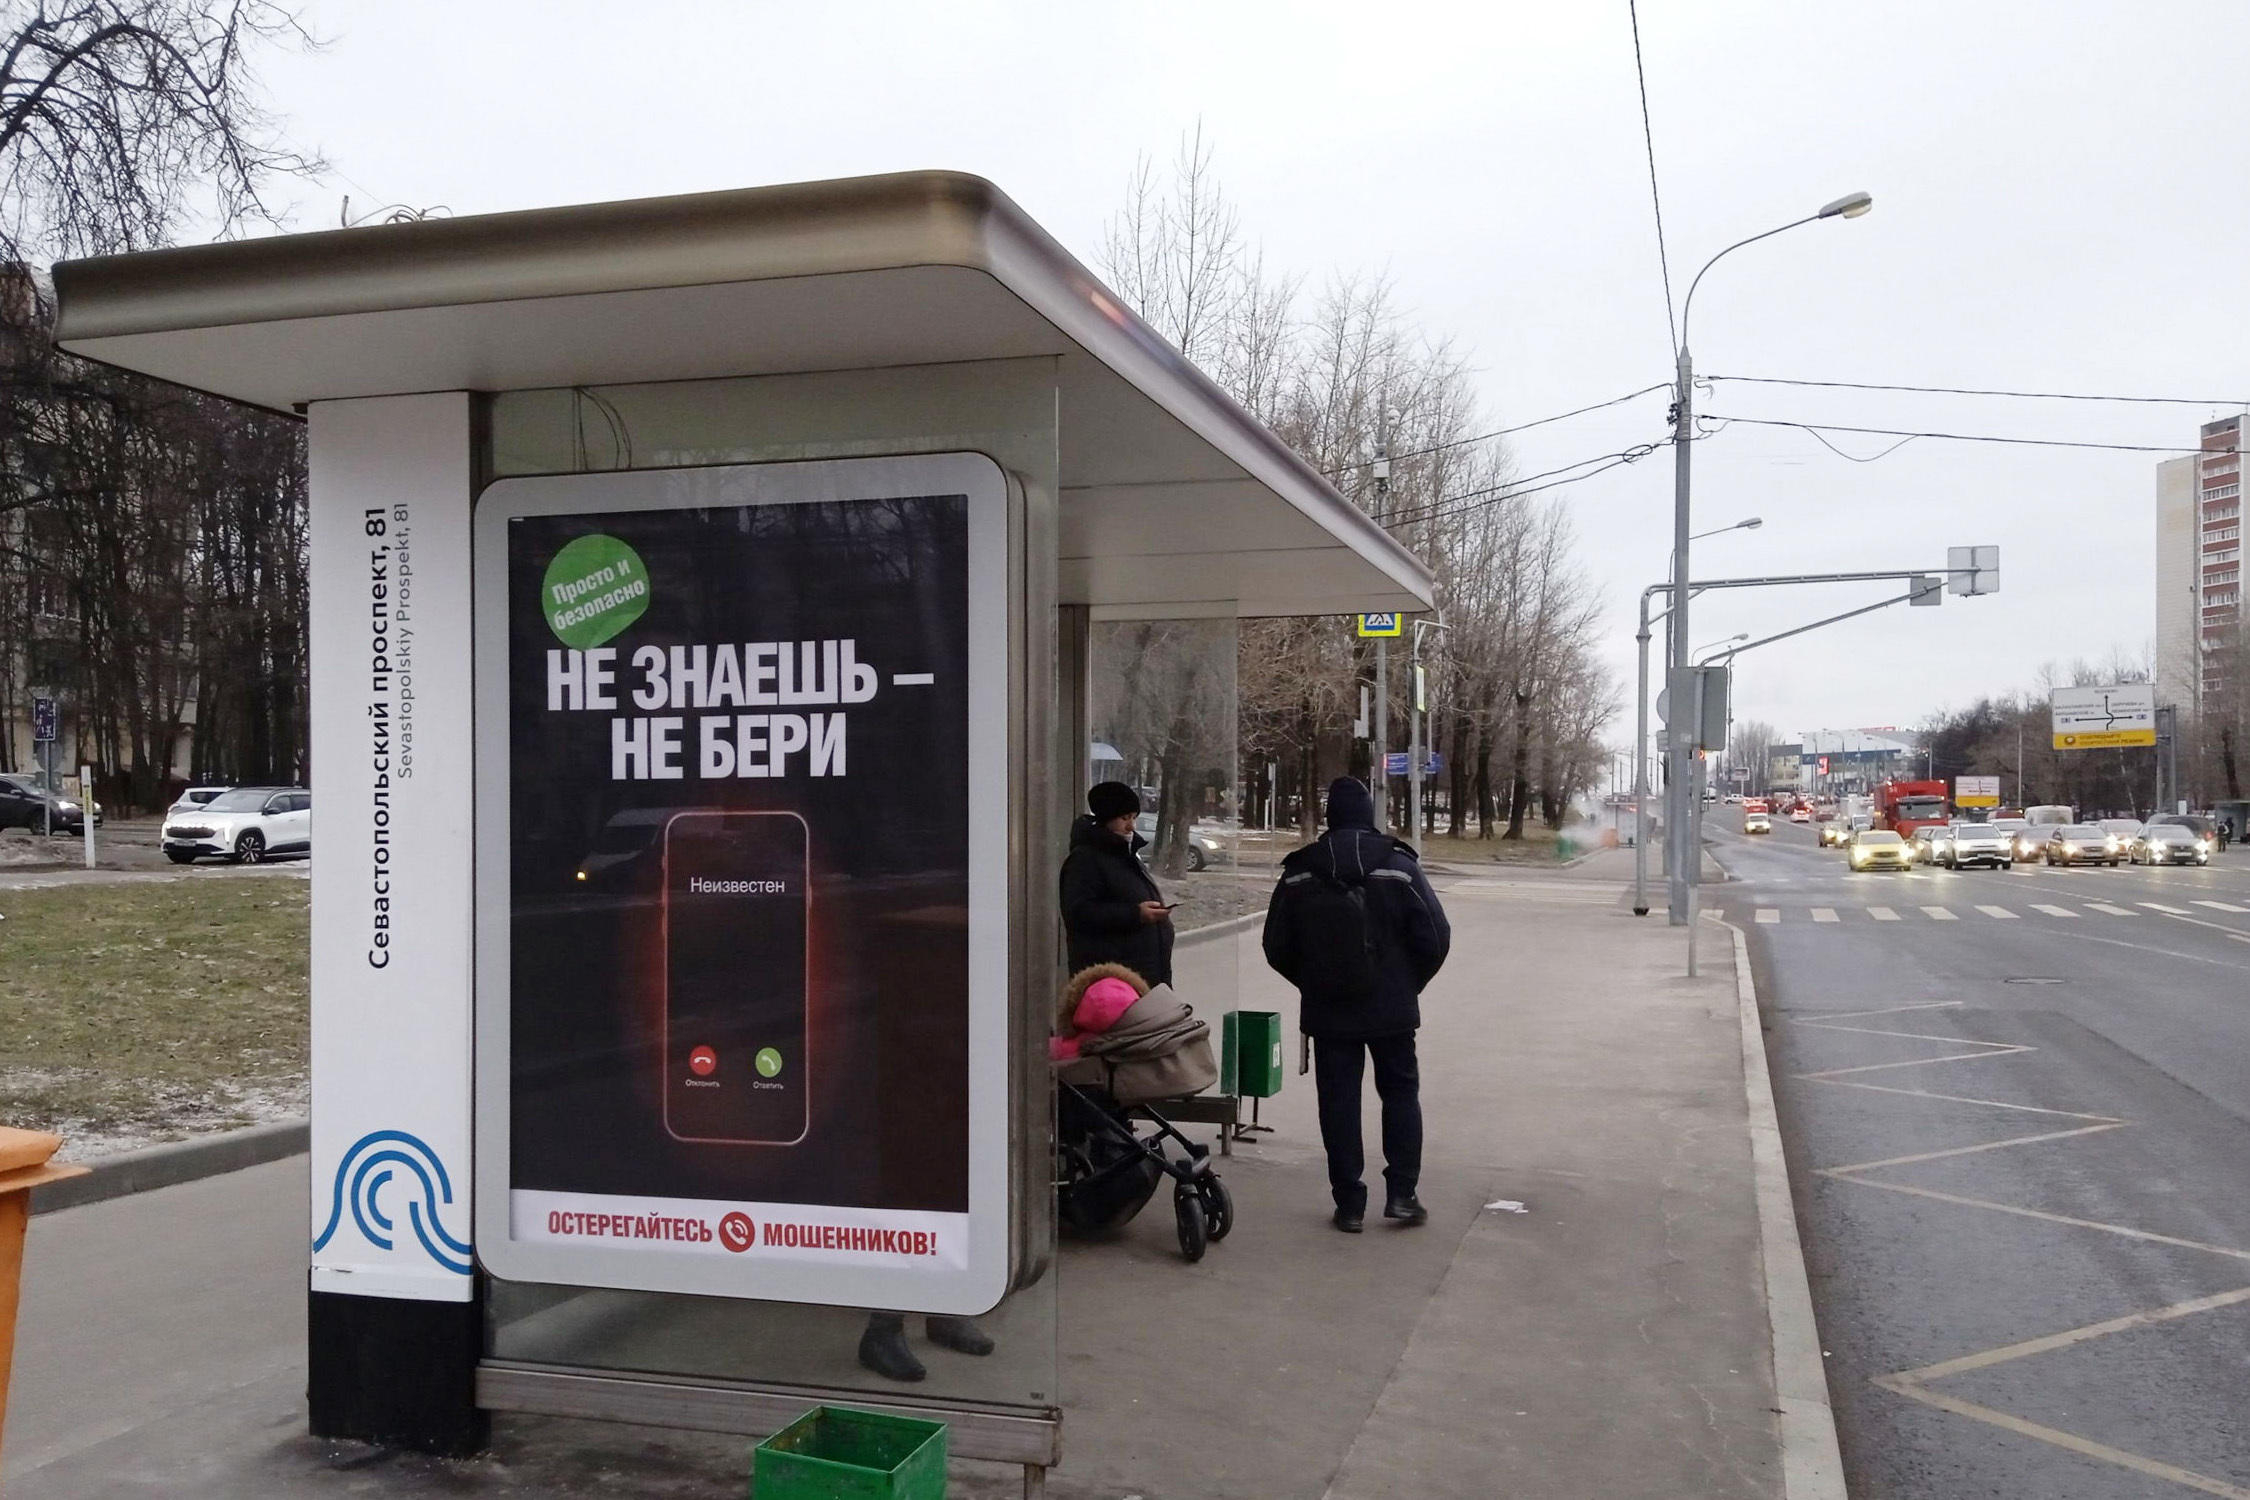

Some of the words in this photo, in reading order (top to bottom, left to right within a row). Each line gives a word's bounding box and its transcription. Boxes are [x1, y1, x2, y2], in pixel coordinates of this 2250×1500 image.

[365, 508, 387, 537] 81
[393, 503, 409, 523] 81
[395, 526, 413, 622] Prospekt,
[552, 566, 615, 604] Просто
[616, 559, 631, 577] и
[372, 545, 393, 692] проспект,
[554, 580, 646, 630] безопасно
[395, 627, 415, 778] Sevastopolskiy
[547, 648, 617, 711] НЕ
[632, 640, 878, 711] ЗНАЕШЬ
[611, 717, 684, 780] НЕ
[700, 712, 847, 779] БЕРИ
[368, 702, 390, 969] Севастопольский
[690, 876, 785, 893] Неизвестен
[548, 1210, 713, 1243] ОСТЕРЕГАЙТЕСЬ
[763, 1223, 937, 1256] МОШЕННИКОВ!
